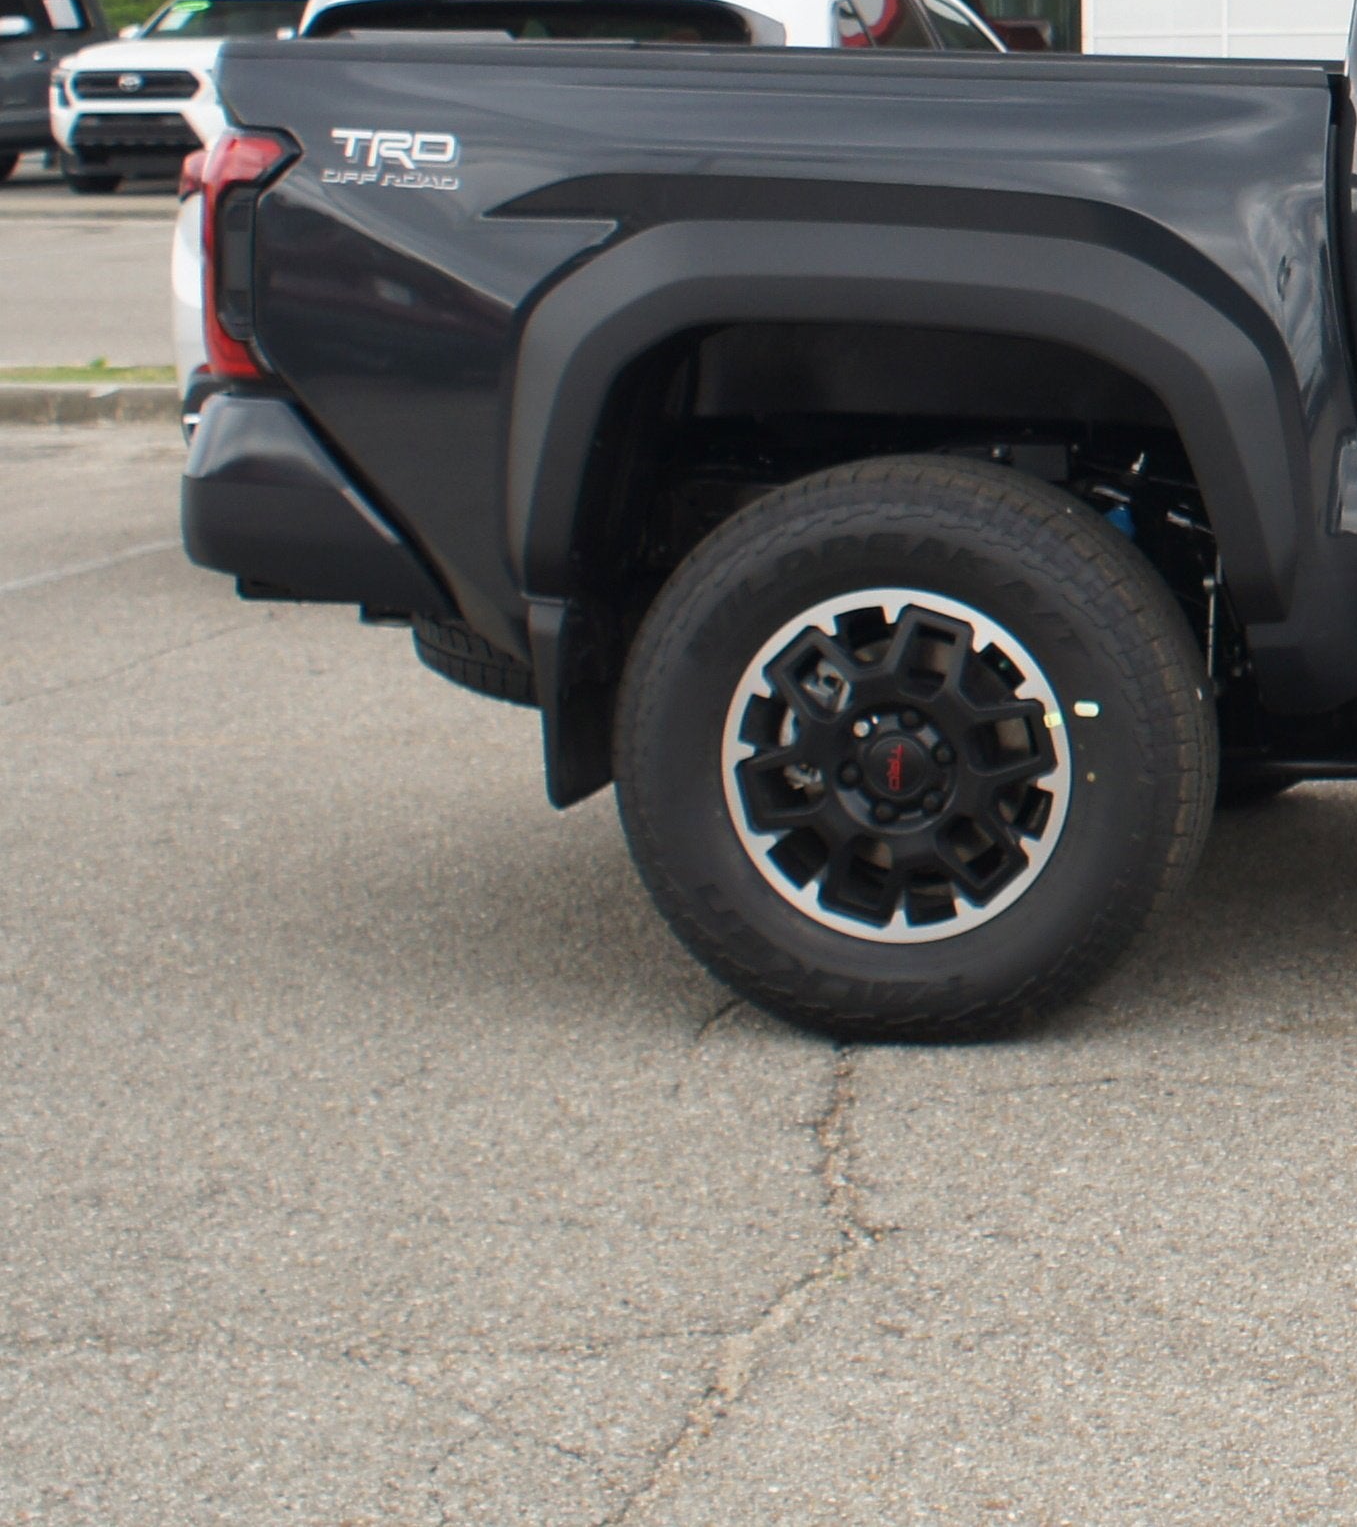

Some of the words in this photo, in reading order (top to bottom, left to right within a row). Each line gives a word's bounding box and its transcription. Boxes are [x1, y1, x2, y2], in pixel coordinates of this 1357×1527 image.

[331, 127, 459, 170] TRD
[321, 169, 377, 186] OFF
[381, 172, 459, 191] ROAD
